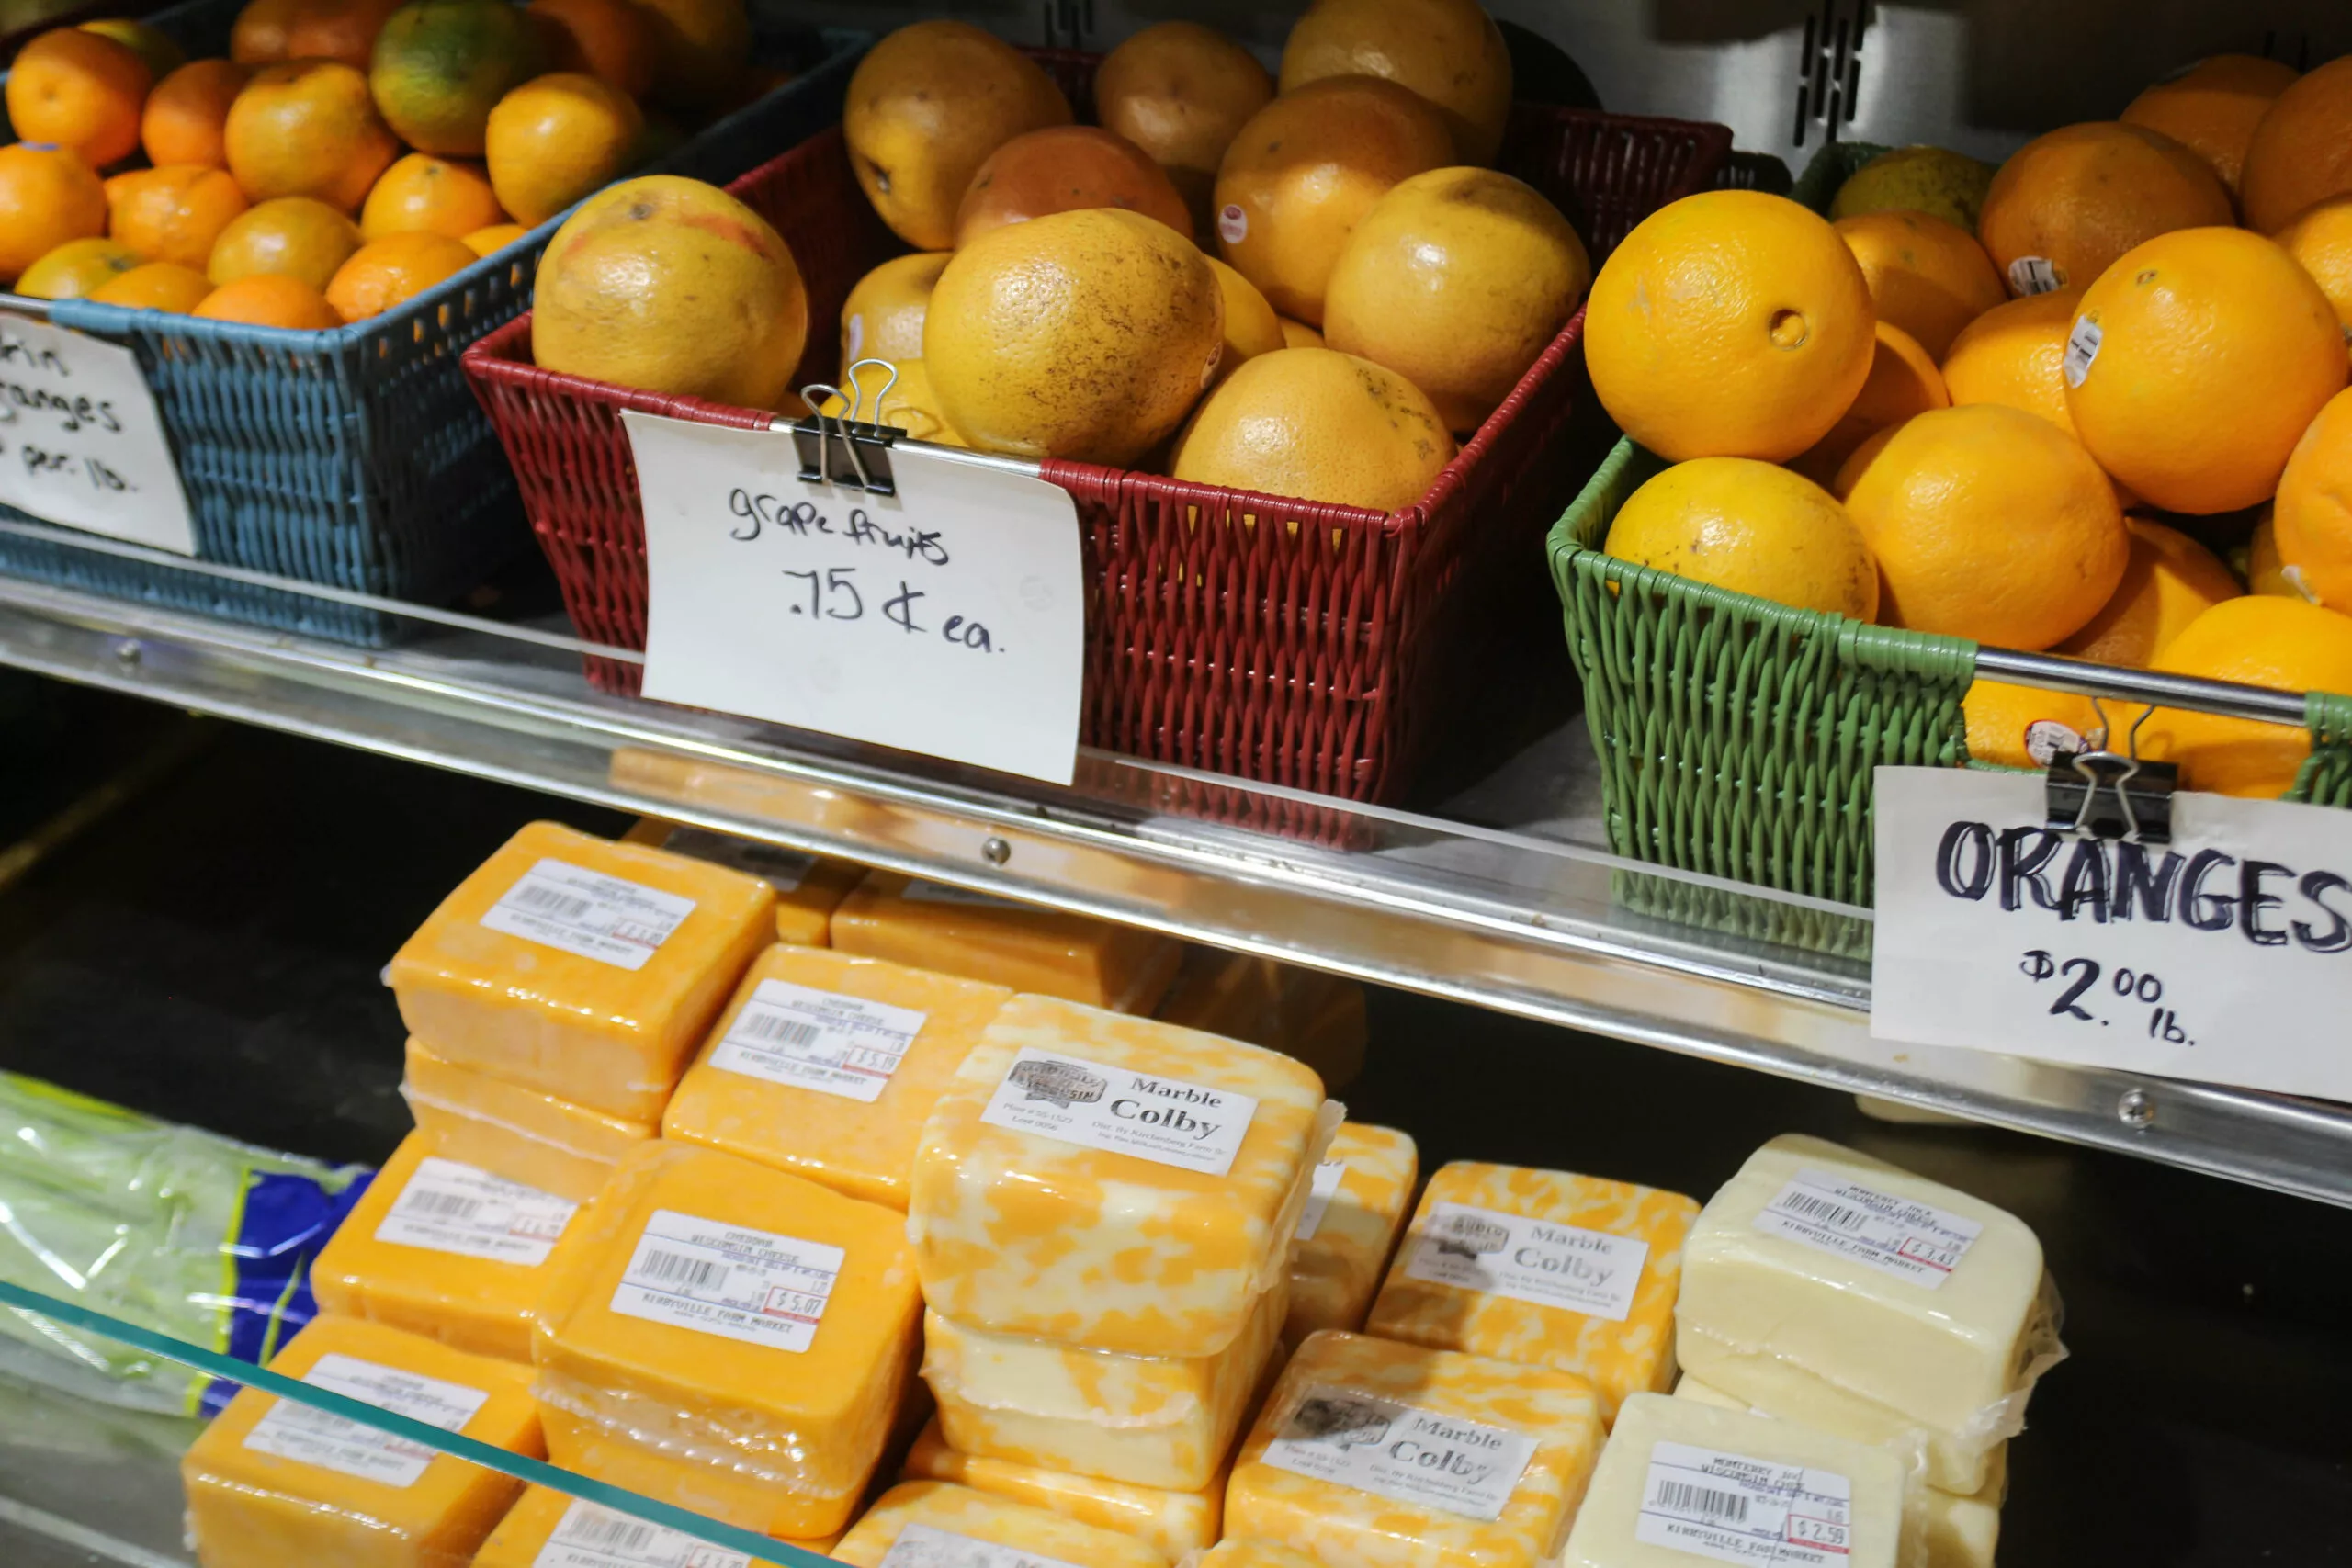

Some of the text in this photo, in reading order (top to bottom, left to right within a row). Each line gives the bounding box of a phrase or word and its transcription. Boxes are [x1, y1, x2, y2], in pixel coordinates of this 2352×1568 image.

[942, 615, 1006, 653] ea.
[1936, 820, 2352, 953] ORANGES
[2150, 1009, 2196, 1046] lb.
[1129, 1077, 1222, 1108] Marble
[1110, 1099, 1222, 1140] Colby
[1531, 1225, 1613, 1254] Marble
[1514, 1247, 1614, 1286] Colby
[1412, 1418, 1503, 1450] Marble
[1389, 1440, 1493, 1484] Colby
